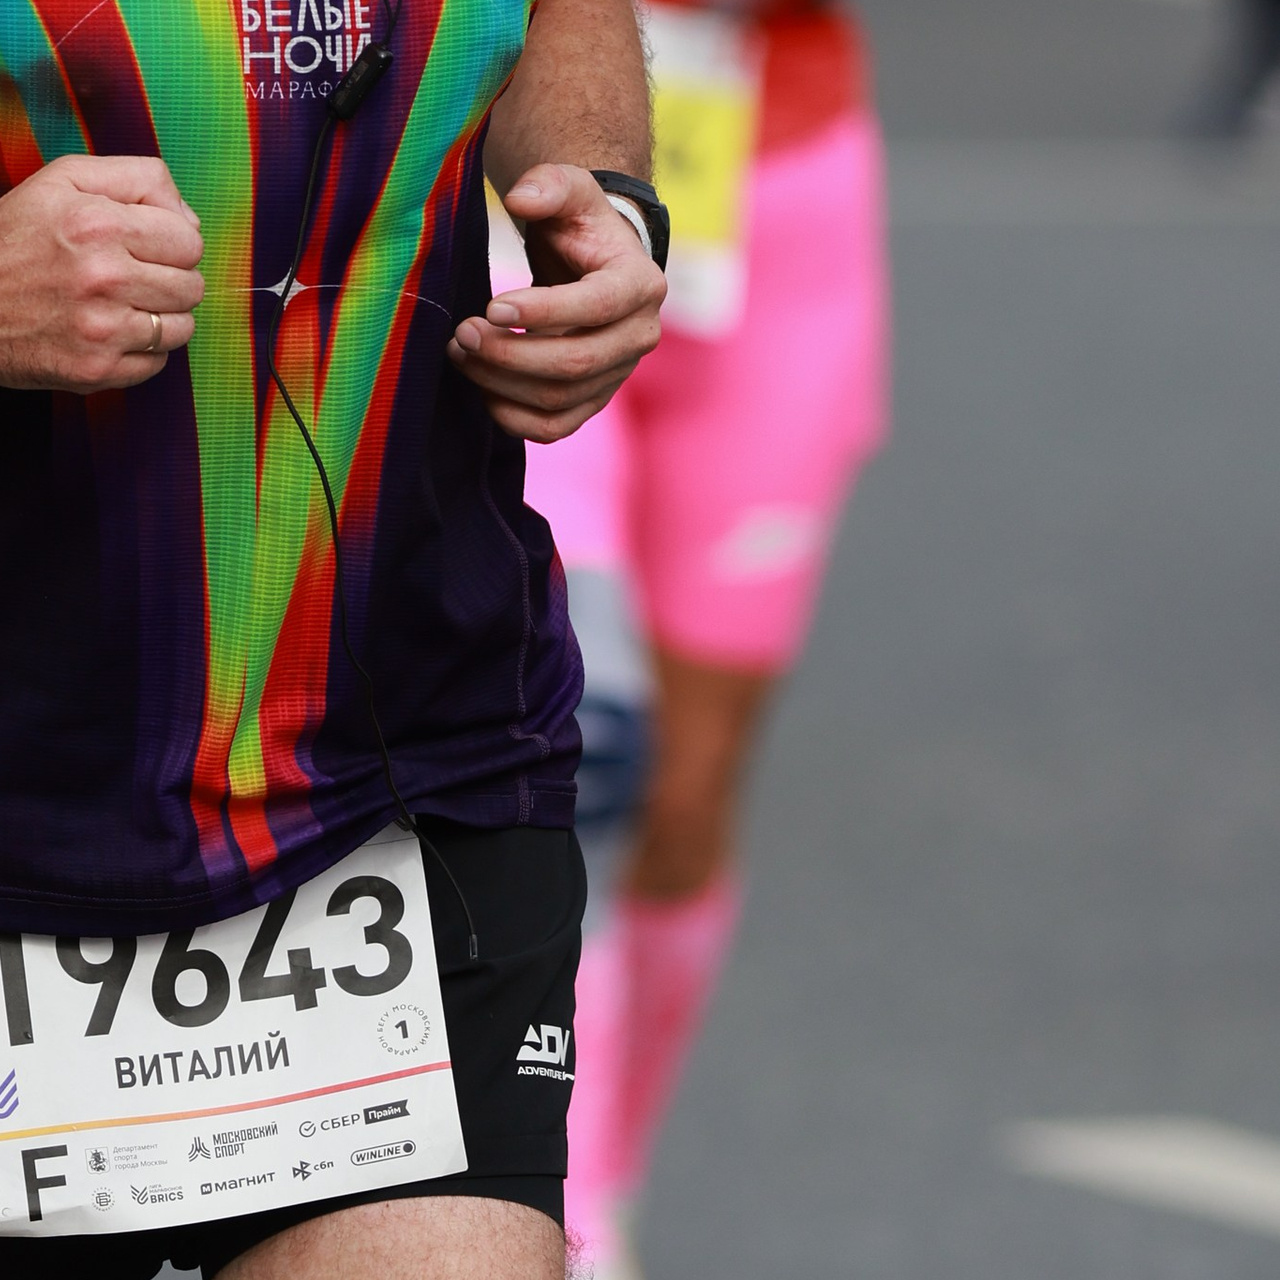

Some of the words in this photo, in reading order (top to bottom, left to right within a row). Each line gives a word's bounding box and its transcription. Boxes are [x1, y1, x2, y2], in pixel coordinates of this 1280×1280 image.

[245, 80, 341, 100] МАРАФ
[392, 1003, 431, 1046] МОСКОВСКИЙ
[394, 1019, 409, 1039] 1
[377, 1035, 419, 1057] МАРАФОН
[114, 1029, 291, 1090] ВИТАЛИЙ
[320, 1113, 361, 1131] СБЕР
[368, 1105, 402, 1121] Прайм
[212, 1121, 279, 1146] МОСКОВСКИЙ
[112, 1143, 158, 1154] Департамент
[113, 1154, 138, 1162] спорта
[214, 1142, 246, 1159] СПОРТ
[355, 1145, 401, 1163] WINLINE
[114, 1162, 139, 1171] города
[140, 1159, 168, 1168] Москвы
[313, 1161, 335, 1171] сбп
[20, 1144, 69, 1222] F
[214, 1171, 276, 1192] магнит
[150, 1190, 184, 1204] BRICS
